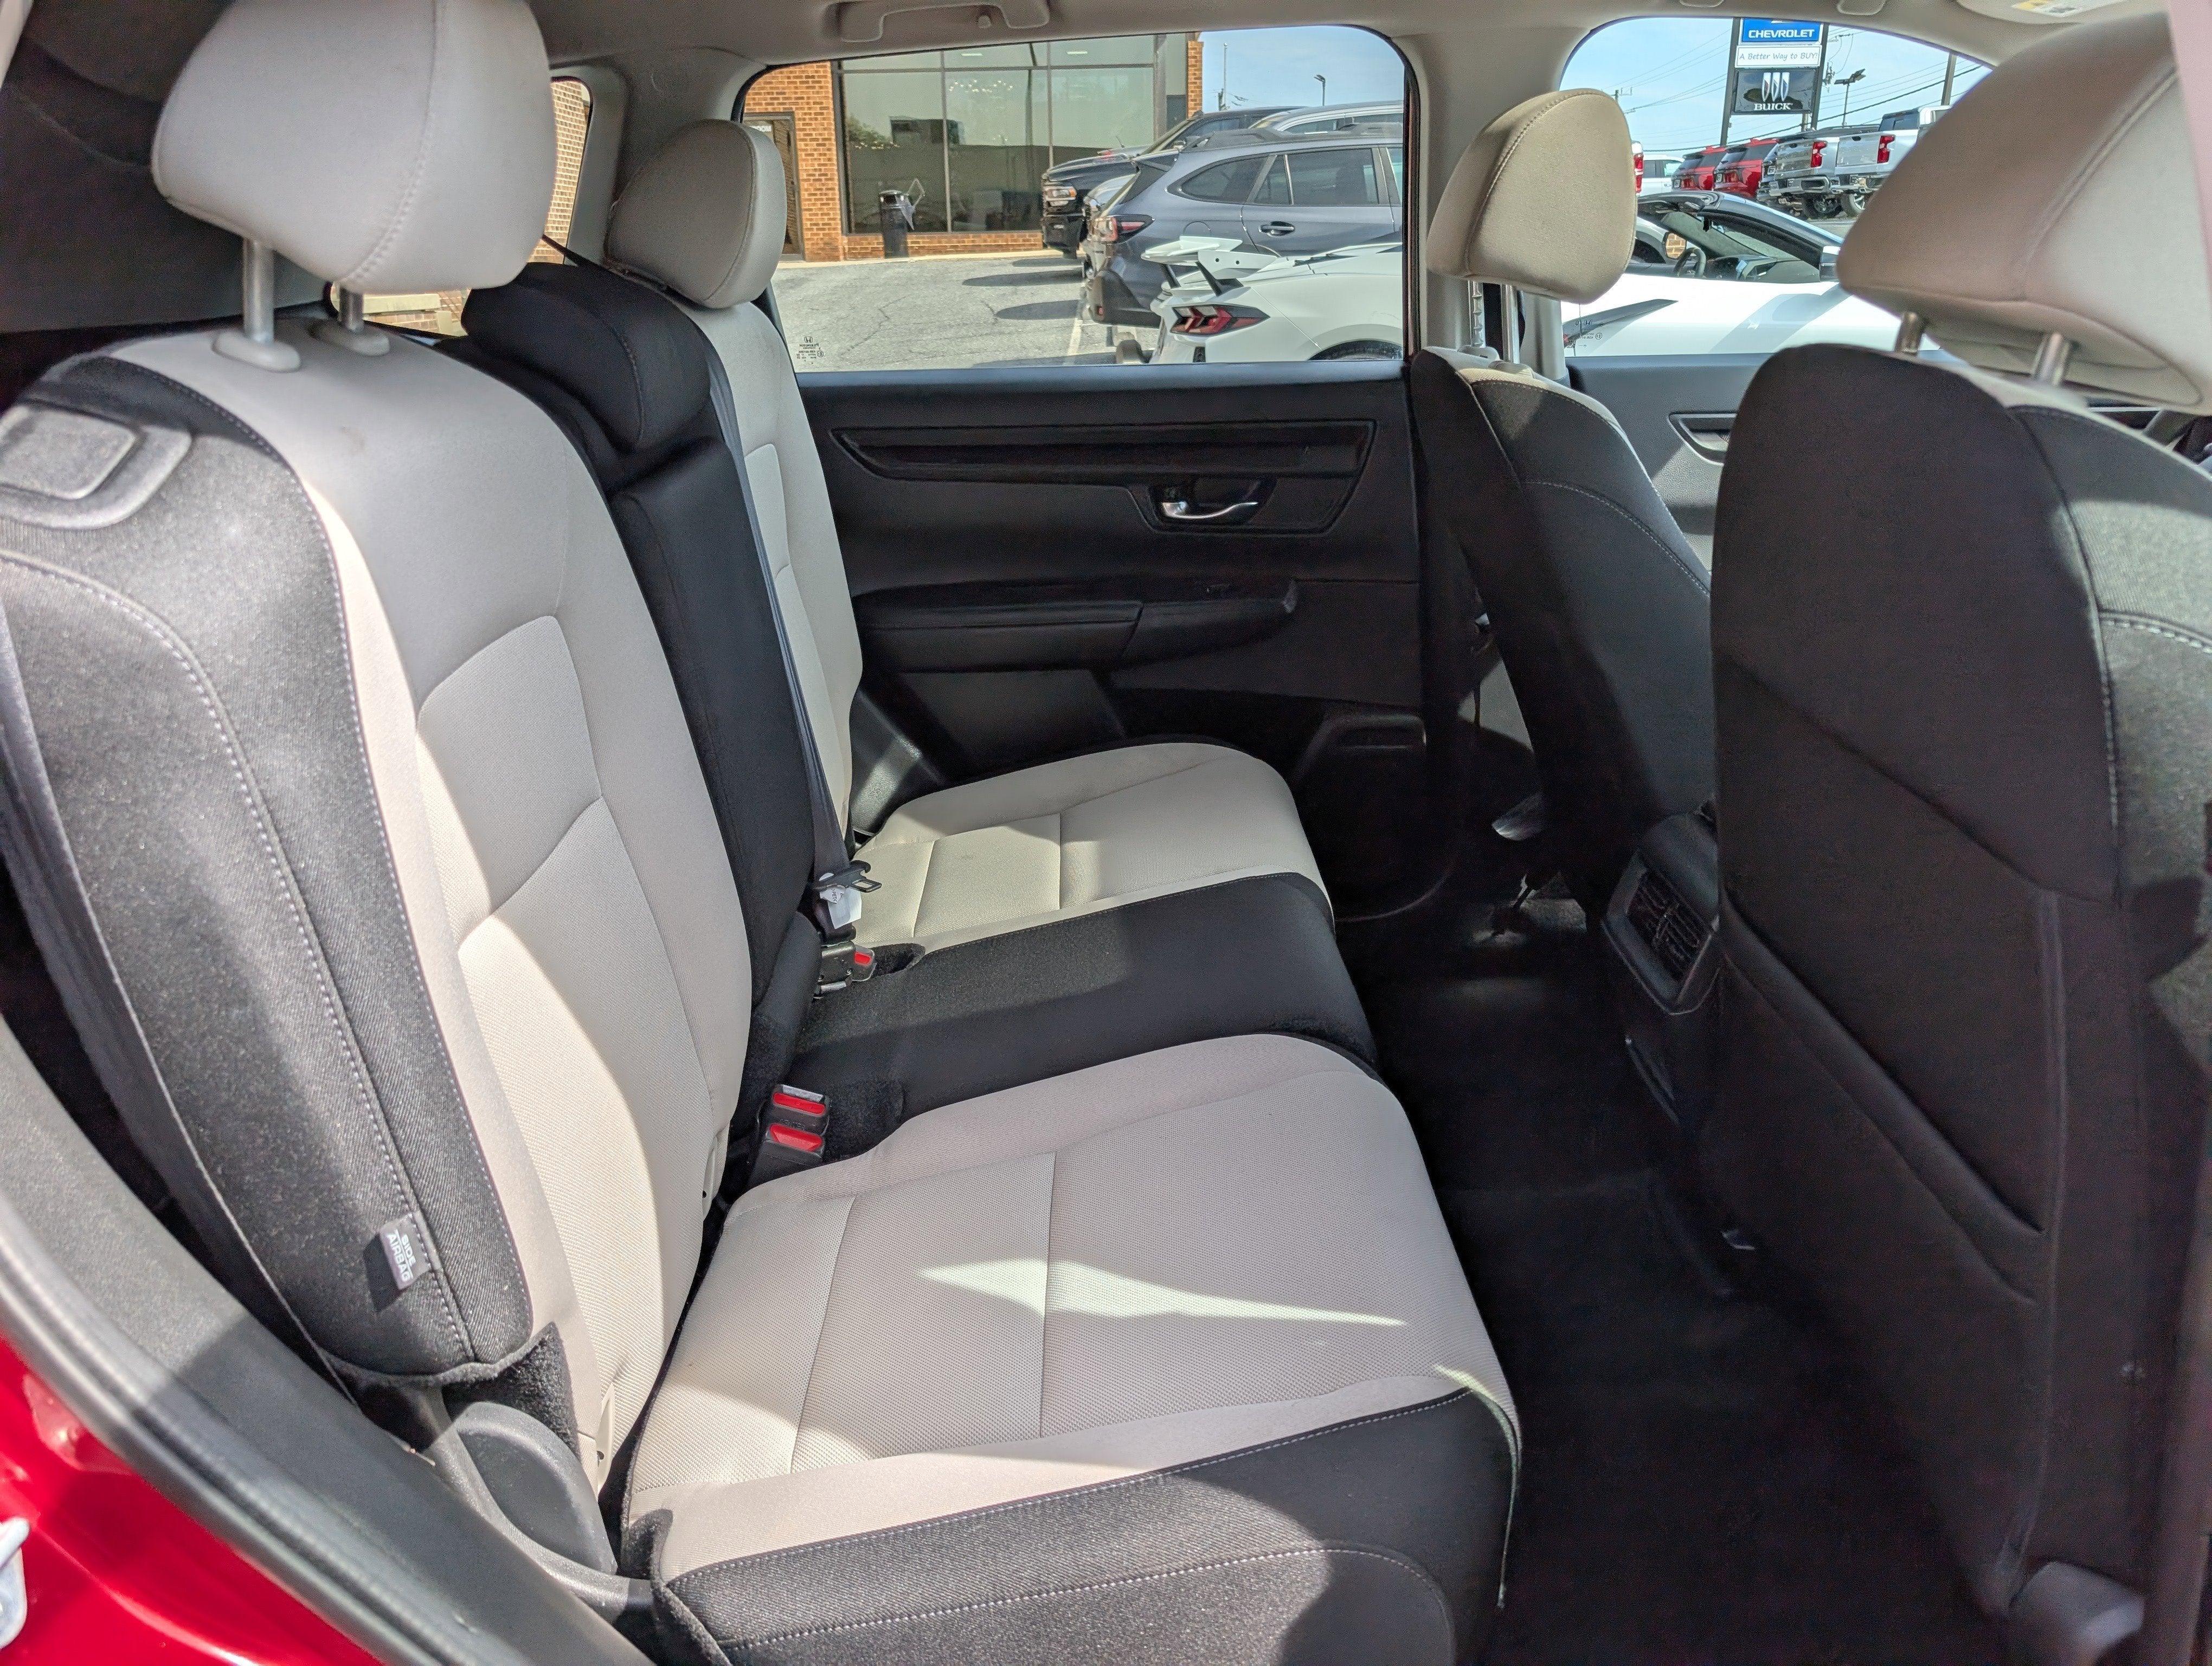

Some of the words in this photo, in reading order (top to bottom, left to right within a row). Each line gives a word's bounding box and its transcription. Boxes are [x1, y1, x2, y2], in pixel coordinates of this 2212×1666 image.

[1748, 29, 1815, 39] CHEVROLET
[1773, 53, 1787, 61] Way
[387, 1234, 410, 1281] AIRBAG
[401, 1234, 416, 1266] SIDE
